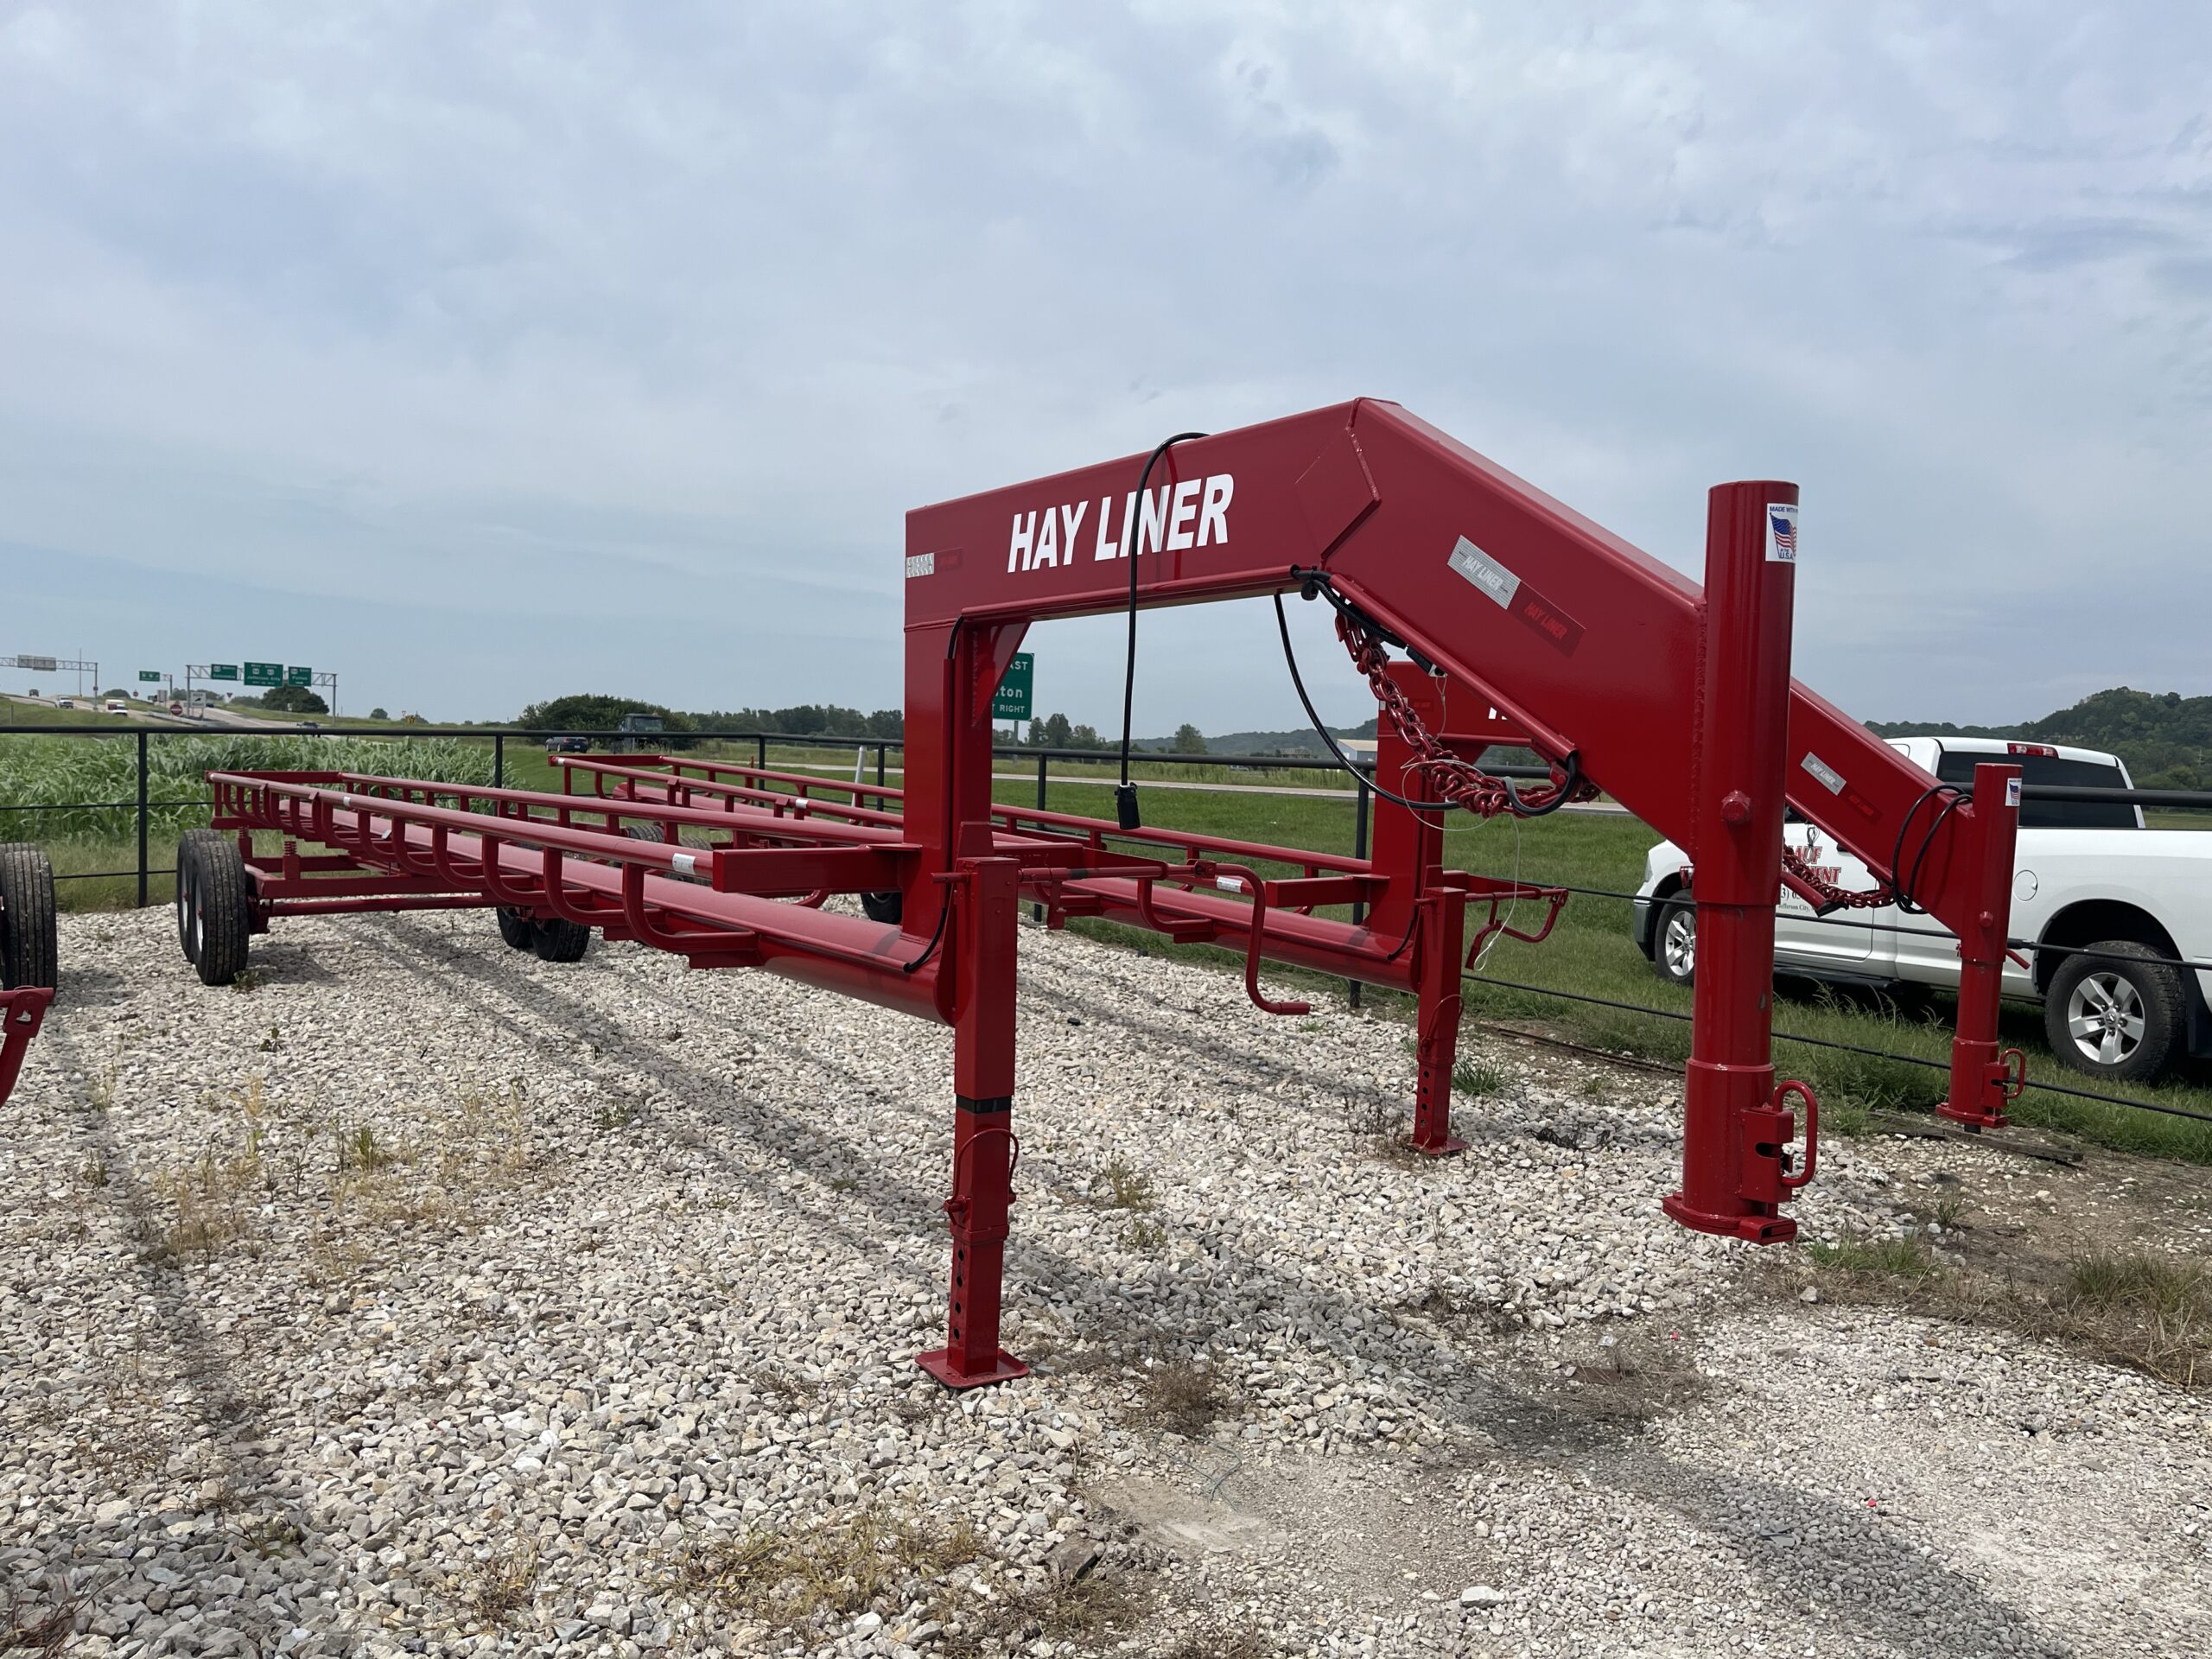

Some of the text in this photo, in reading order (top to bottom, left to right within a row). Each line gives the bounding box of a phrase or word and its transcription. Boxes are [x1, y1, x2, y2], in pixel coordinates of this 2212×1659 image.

[1007, 474, 1235, 573] HAY LINER
[1462, 556, 1503, 591] HAY LINER
[1009, 661, 1028, 671] AST
[995, 685, 1023, 698] ton
[1000, 704, 1026, 714] RIGHT
[1794, 846, 1822, 864] AUF
